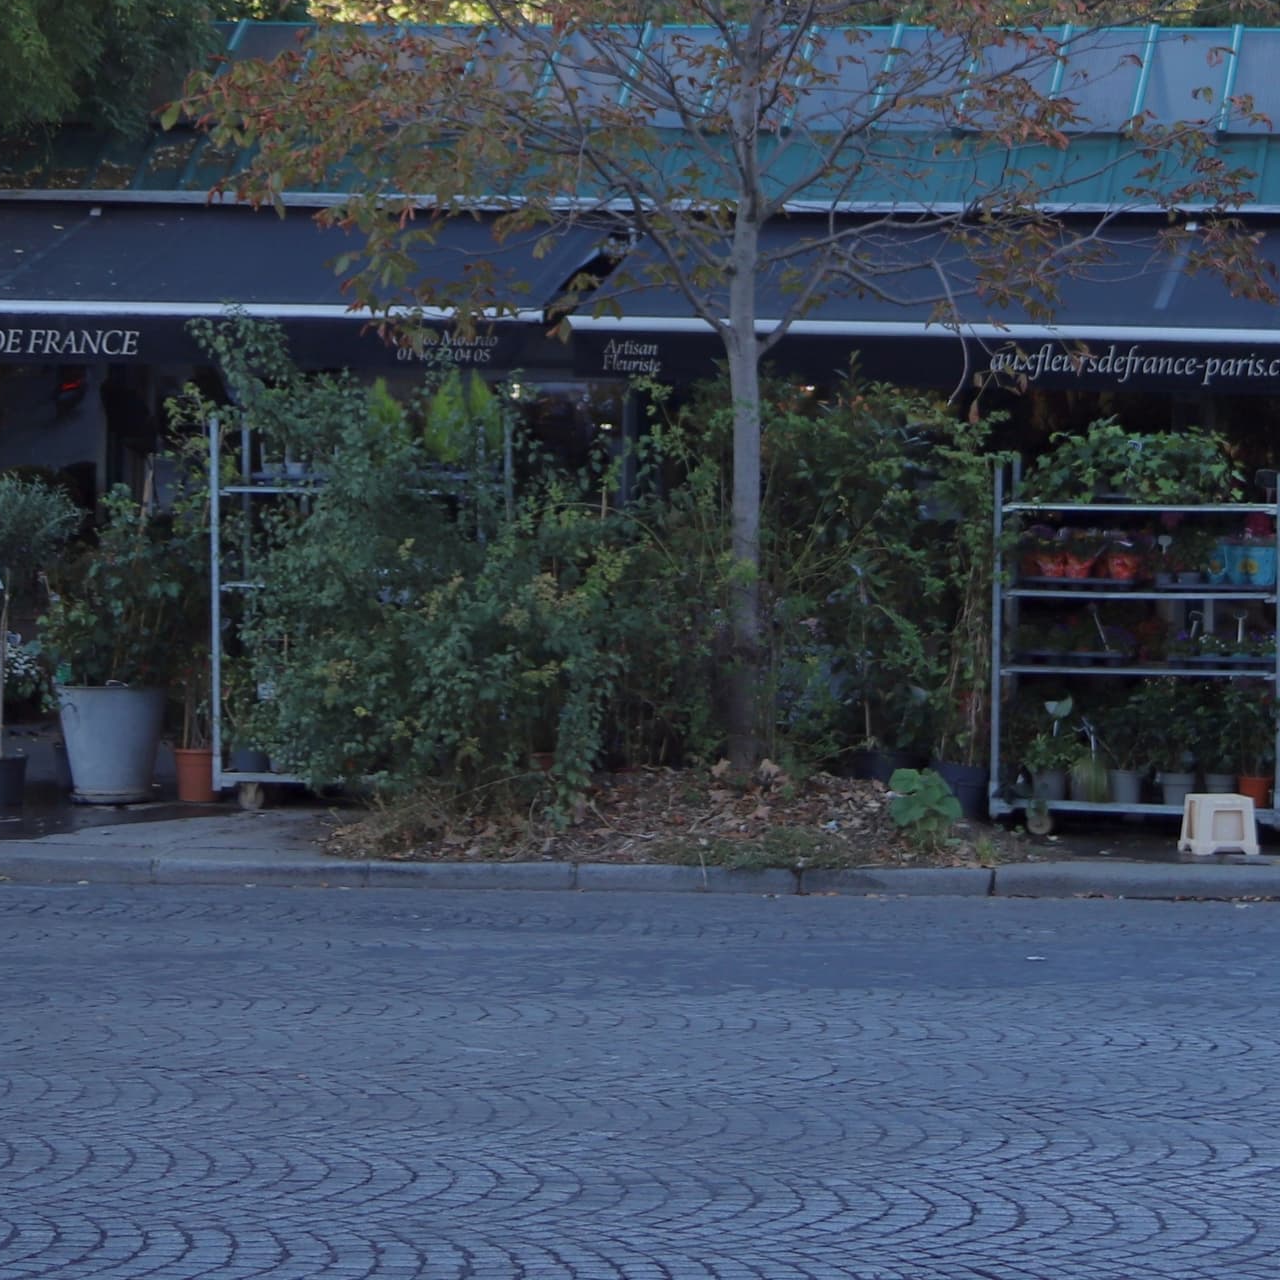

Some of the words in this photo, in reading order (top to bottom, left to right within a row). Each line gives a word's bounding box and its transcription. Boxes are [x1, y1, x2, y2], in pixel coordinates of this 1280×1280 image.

[27, 328, 141, 356] FRANCE
[601, 338, 659, 356] Artisan
[396, 348, 414, 361] 01
[455, 348, 472, 362] 04
[474, 348, 491, 363] 05
[602, 354, 662, 373] Fleuriste
